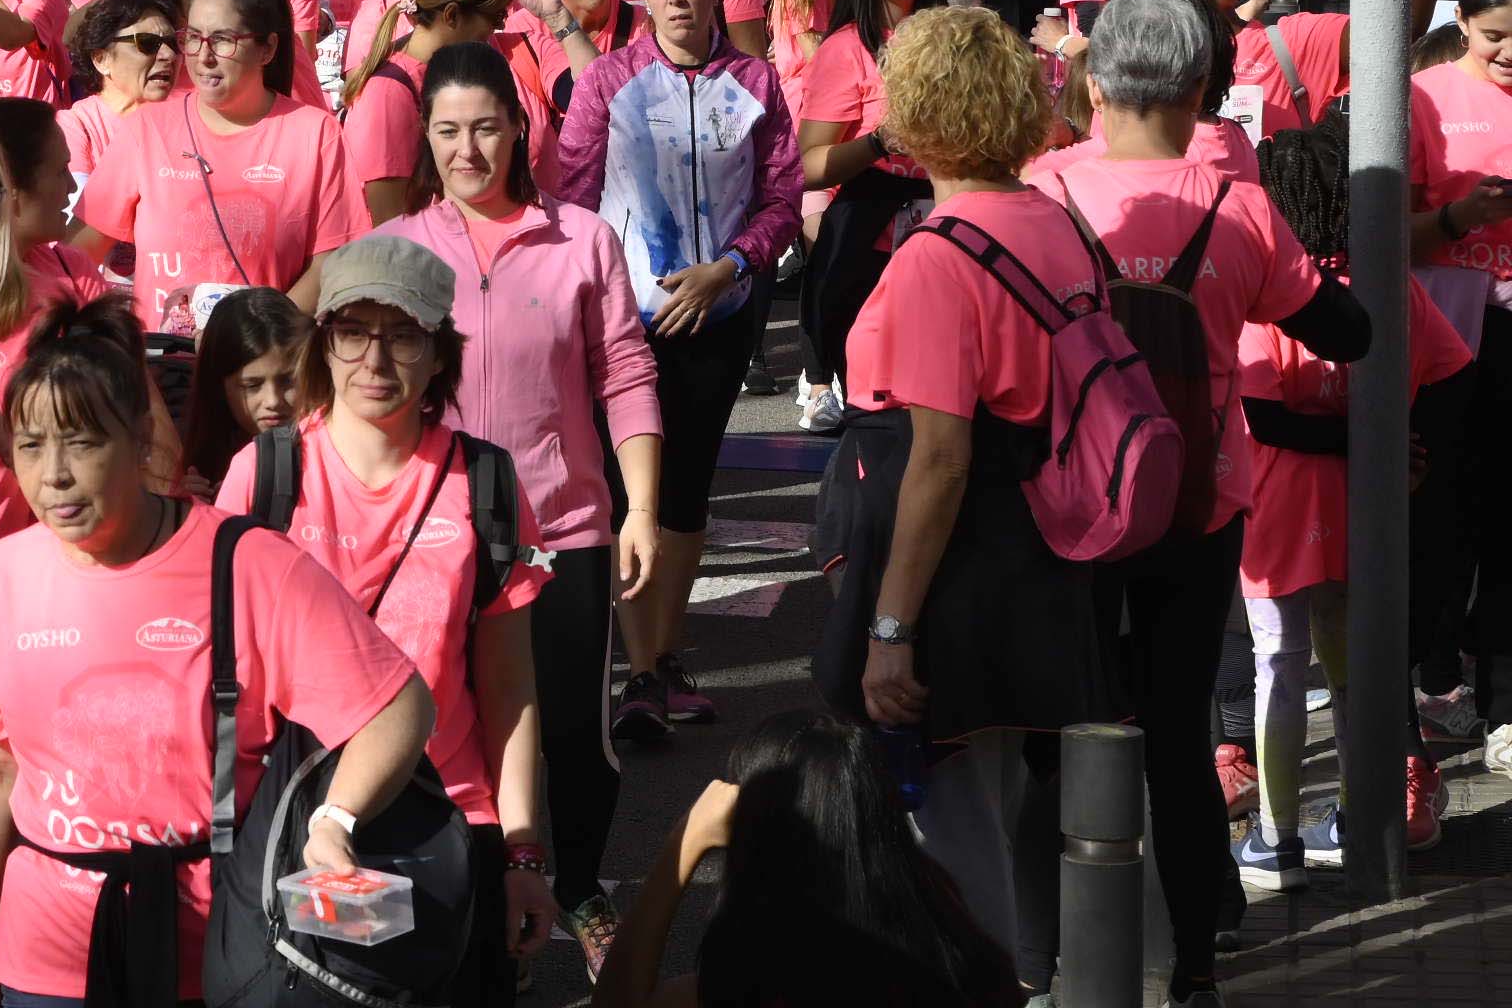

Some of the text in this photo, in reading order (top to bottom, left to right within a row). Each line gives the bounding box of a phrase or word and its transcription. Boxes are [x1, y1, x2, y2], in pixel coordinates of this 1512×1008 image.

[1441, 121, 1491, 135] OYSHO
[148, 251, 183, 278] TU
[17, 627, 81, 652] OYSHO
[141, 629, 201, 644] ASTURIANA
